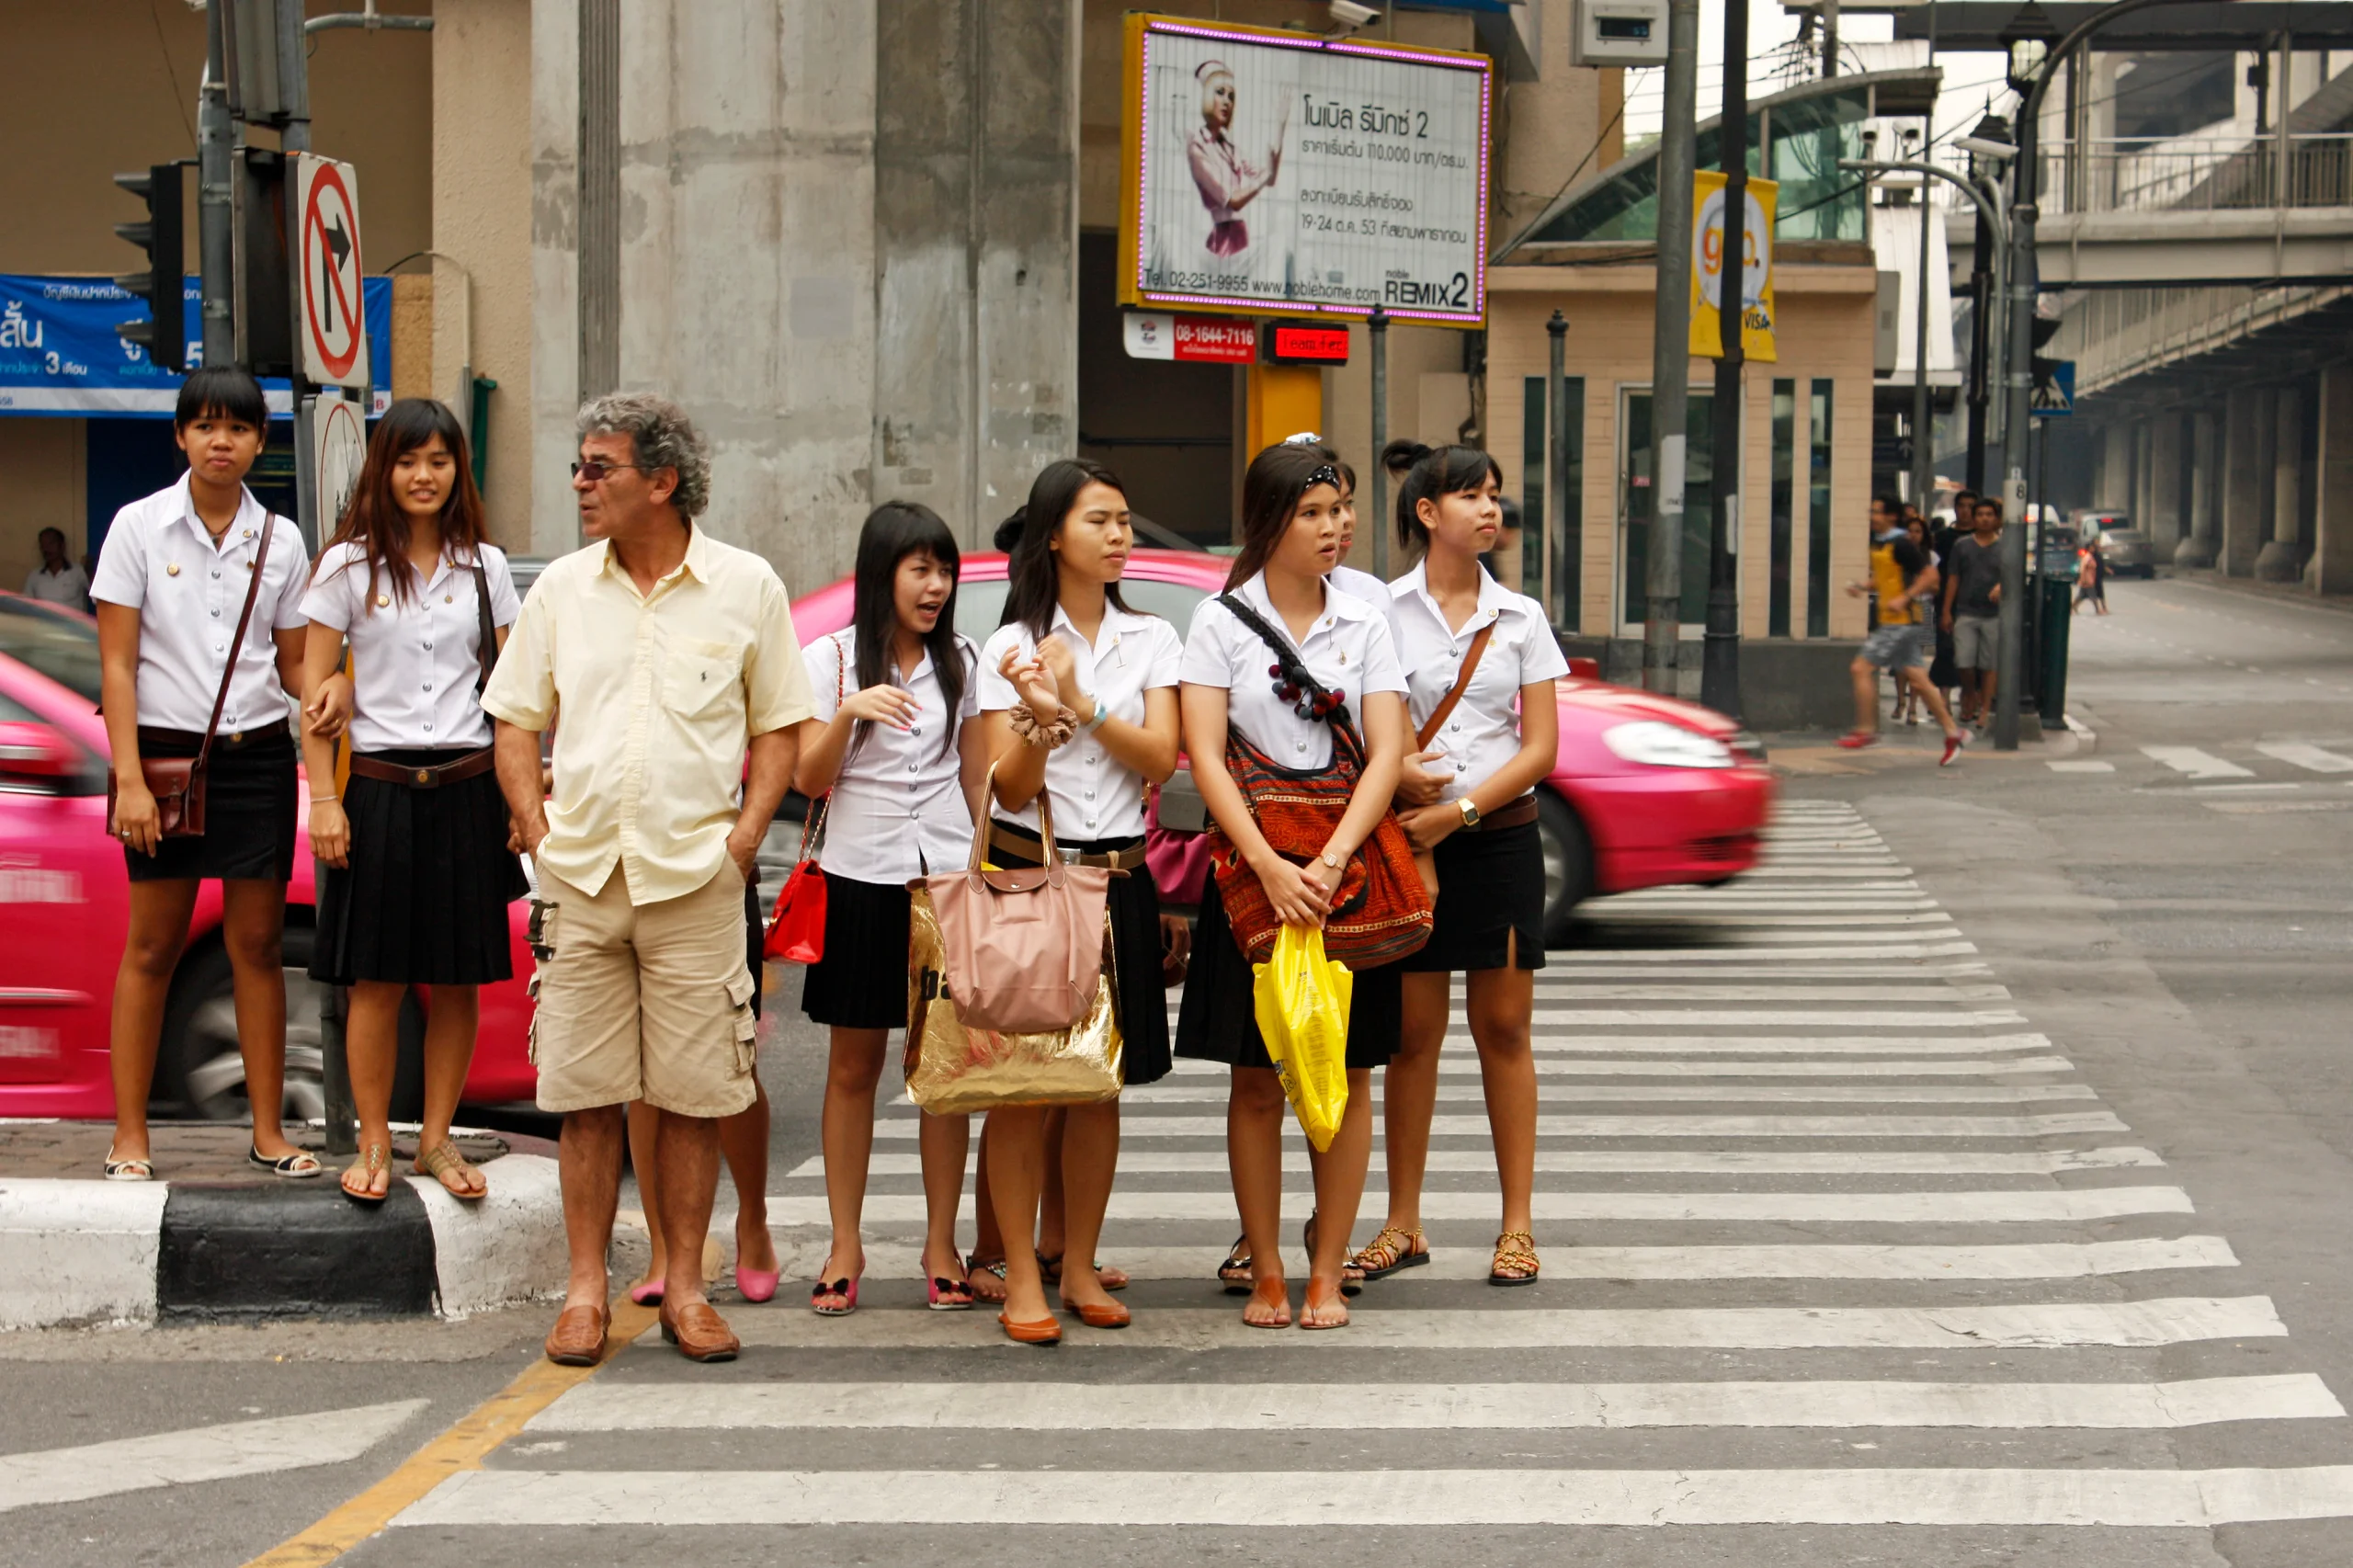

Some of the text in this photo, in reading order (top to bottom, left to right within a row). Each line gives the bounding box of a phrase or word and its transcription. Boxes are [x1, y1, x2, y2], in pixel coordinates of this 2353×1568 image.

[1303, 94, 1428, 139] โนเบิล รีมิกซ์ 2
[1302, 213, 1332, 231] 19-24
[1360, 219, 1377, 235] 53
[1143, 268, 1166, 288] Tel.
[1169, 271, 1249, 292] 02-251-9955
[1252, 279, 1381, 301] www.noblehome.com
[1385, 269, 1410, 280] noble
[1745, 312, 1770, 331] VISA
[1176, 324, 1255, 347] 08-1644-7116
[45, 350, 60, 376] 3
